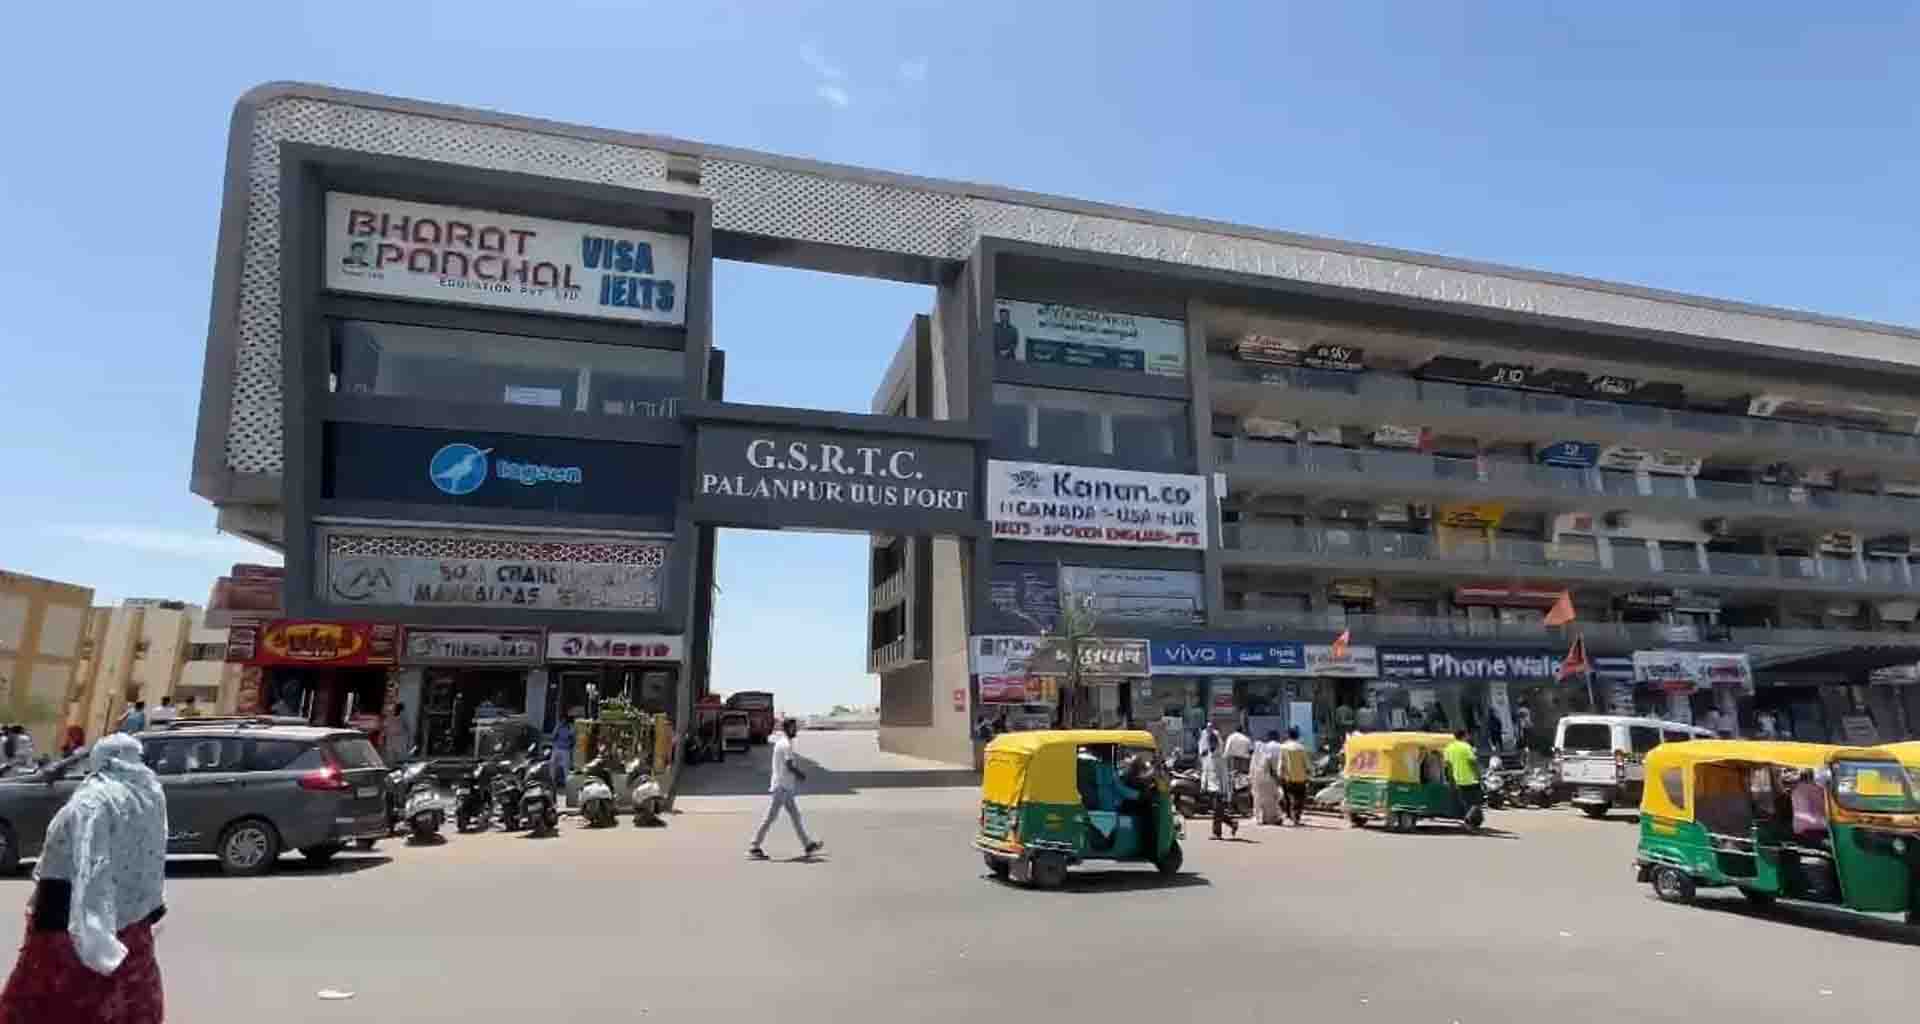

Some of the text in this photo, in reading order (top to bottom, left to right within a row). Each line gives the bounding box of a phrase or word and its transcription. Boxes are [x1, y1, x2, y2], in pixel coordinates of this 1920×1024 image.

[347, 209, 537, 257] BHARAT
[375, 242, 581, 291] PANCHAL
[581, 235, 655, 274] VISA
[599, 274, 675, 313] IELTS
[746, 439, 923, 479] G.S.R.T.C.
[702, 473, 842, 502] PALANPUR
[903, 487, 968, 510] PORT
[1053, 471, 1191, 505] Kanan.co
[1164, 643, 1217, 664] vivo
